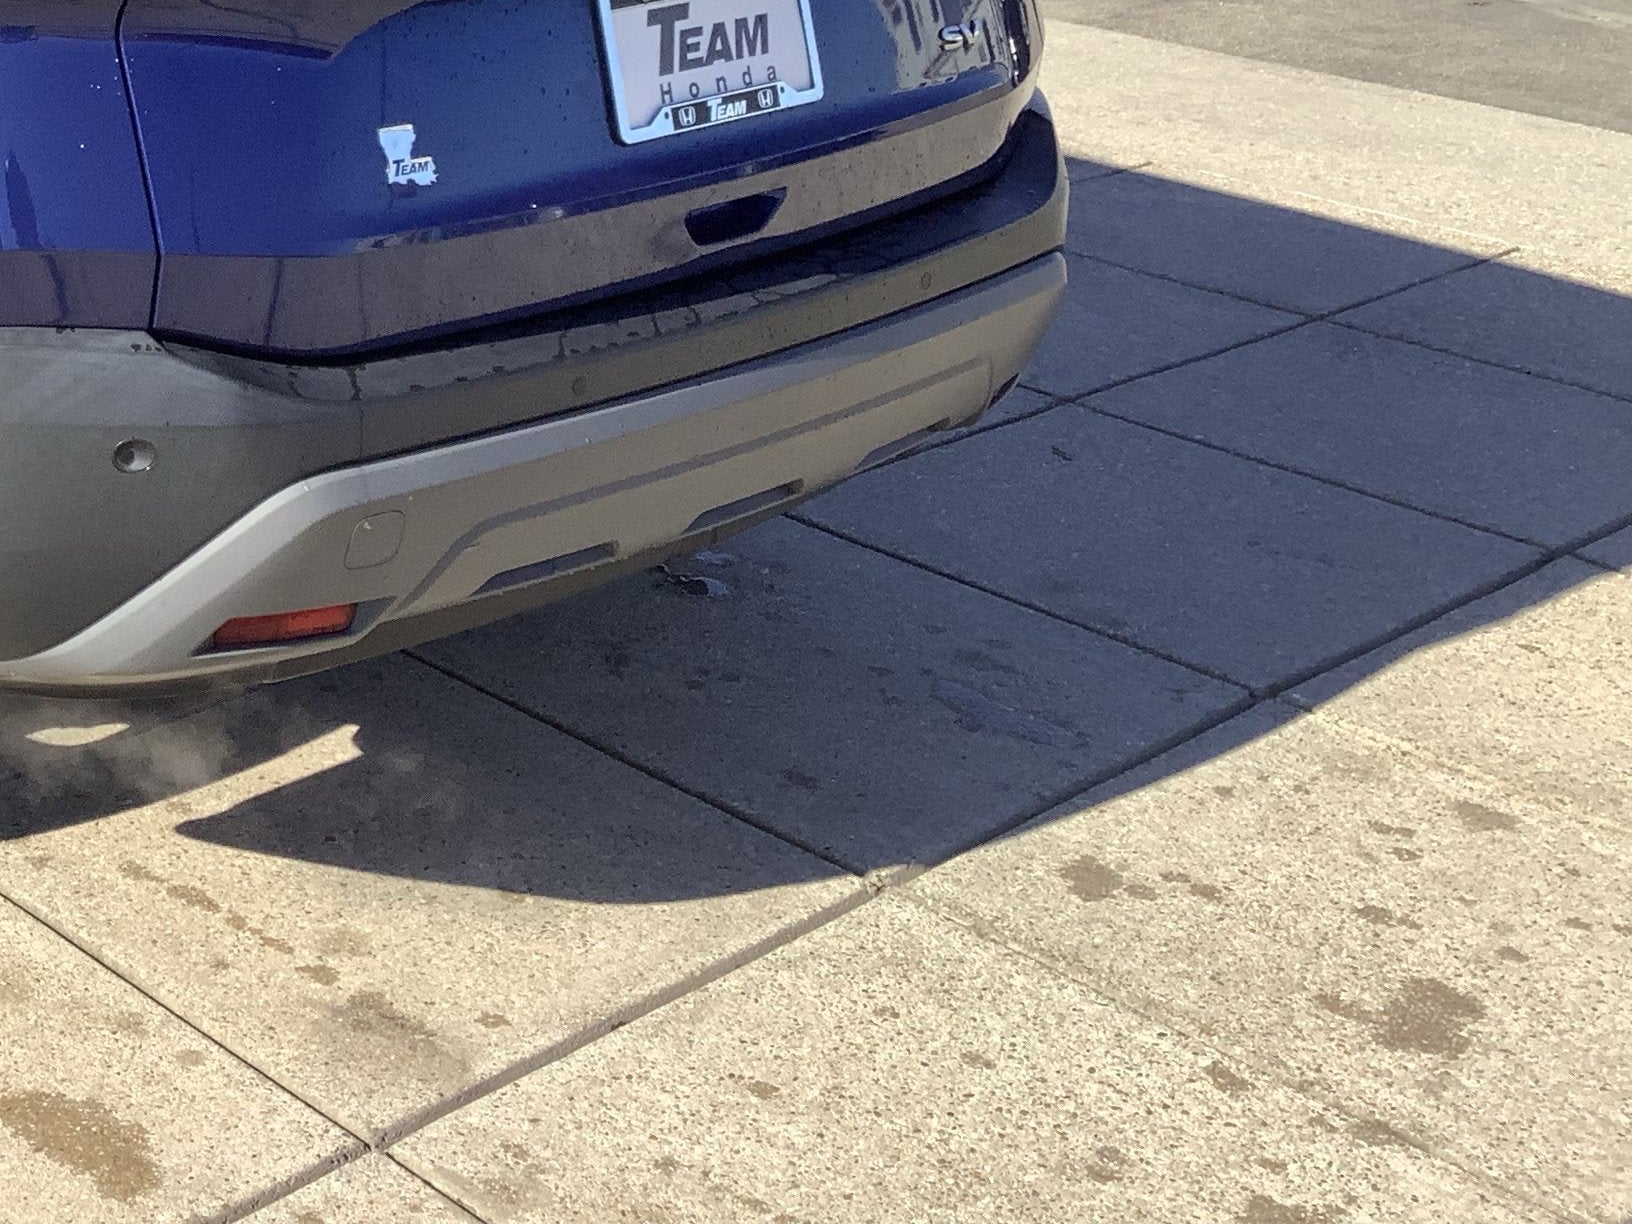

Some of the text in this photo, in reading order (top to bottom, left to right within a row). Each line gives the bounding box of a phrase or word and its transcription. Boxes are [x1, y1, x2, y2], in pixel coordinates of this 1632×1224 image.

[646, 2, 770, 77] TEAM
[941, 19, 984, 51] SV
[659, 65, 778, 104] Honda
[707, 97, 747, 122] TEAM
[392, 158, 429, 177] TEAM
